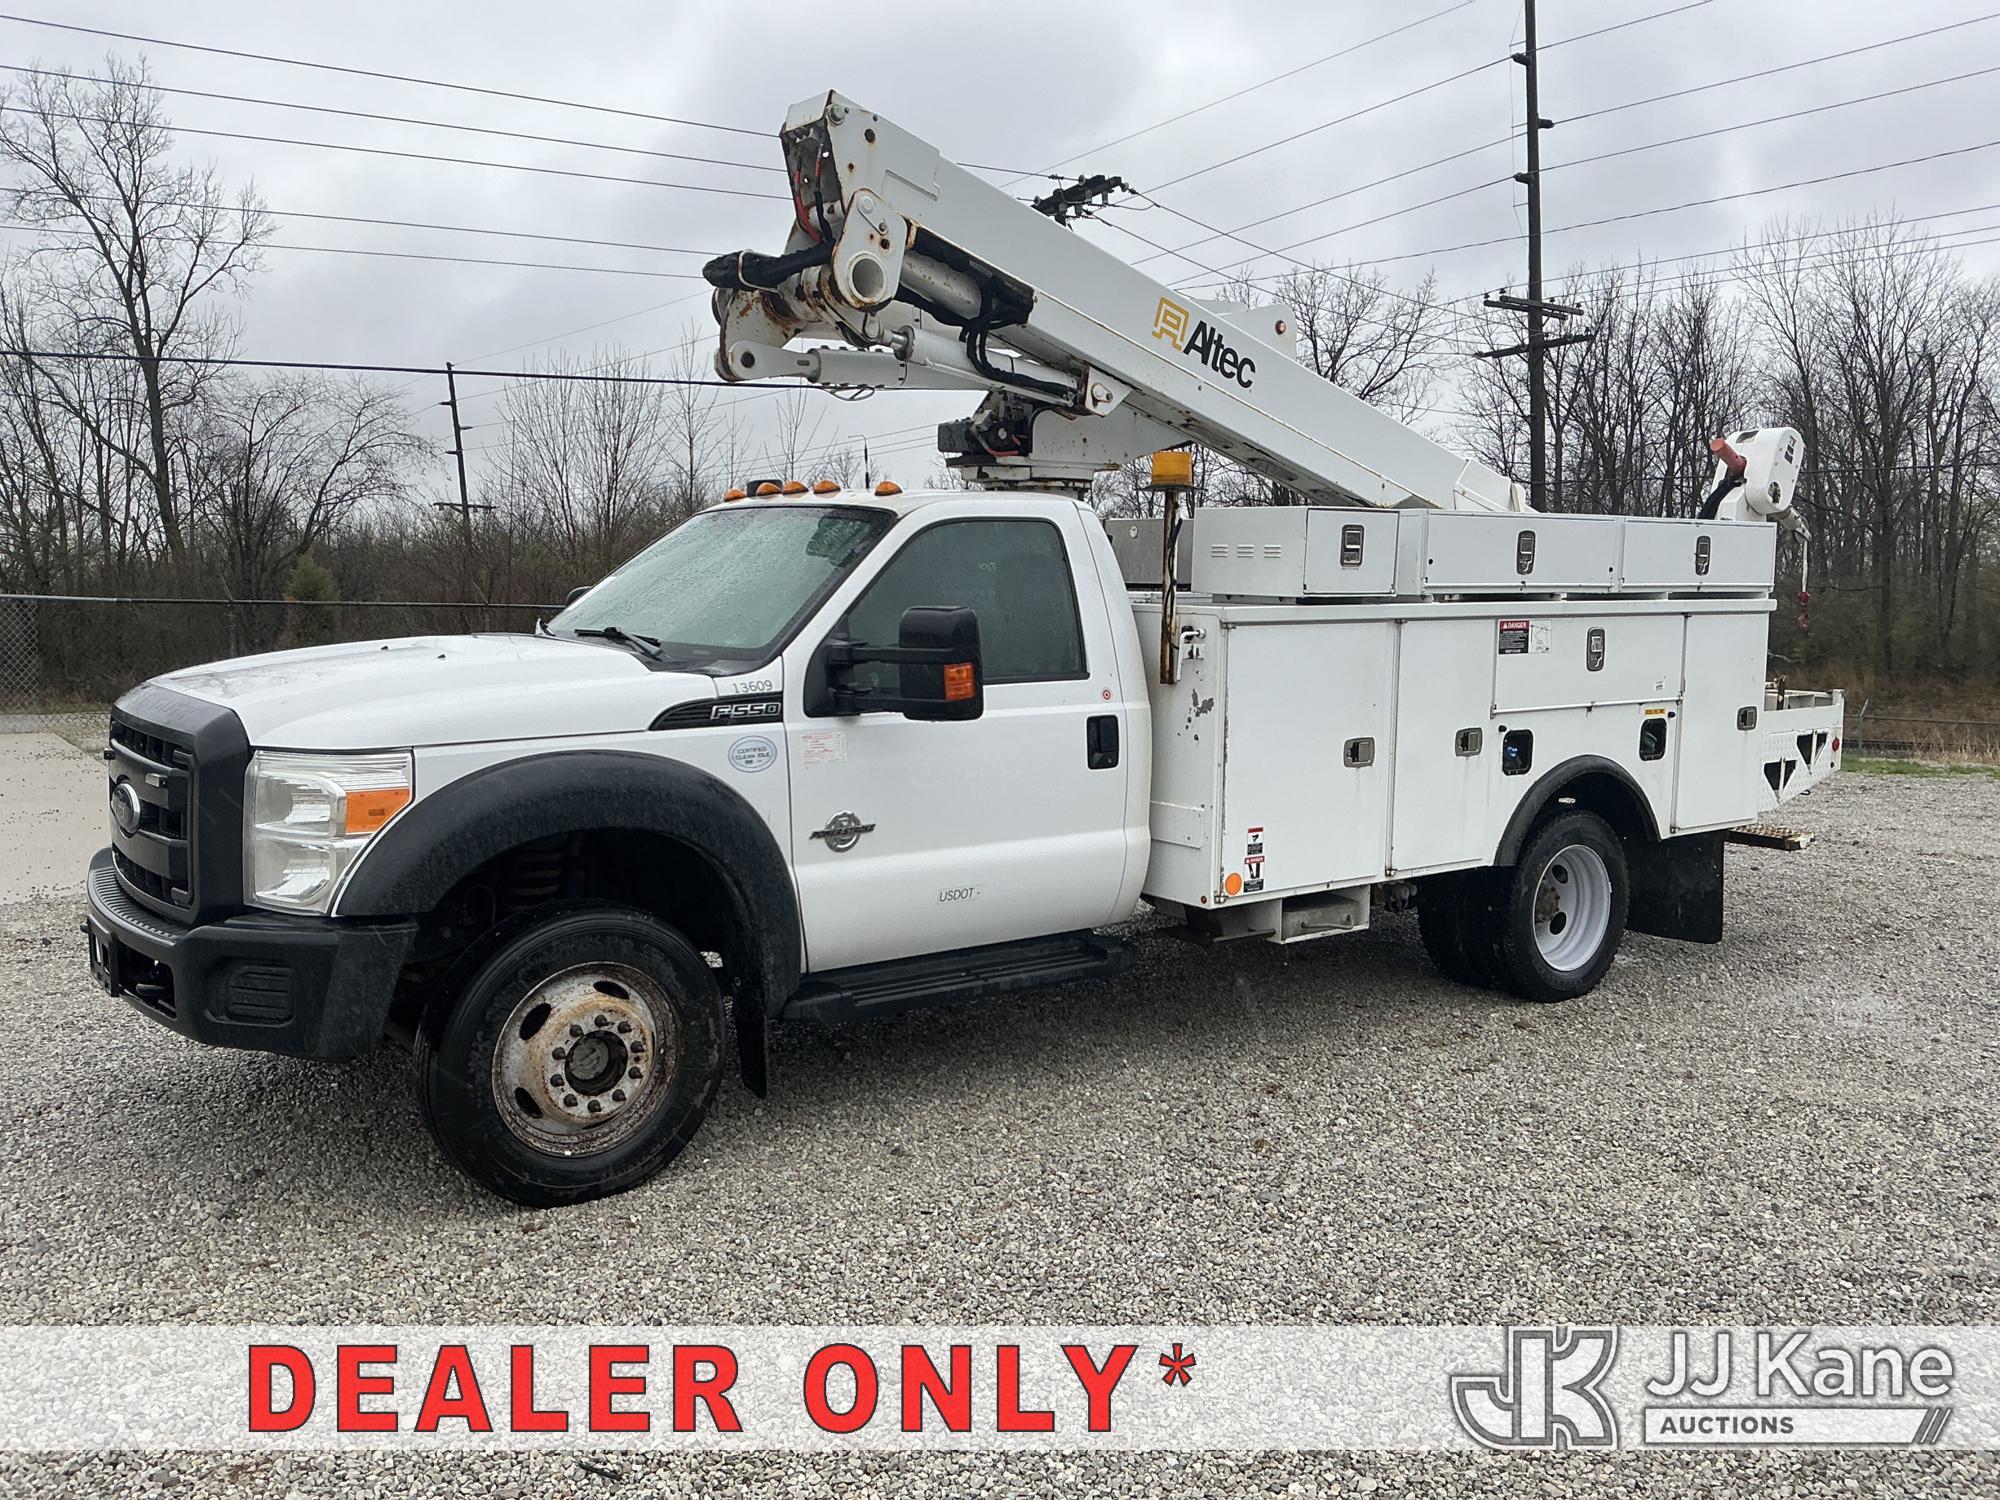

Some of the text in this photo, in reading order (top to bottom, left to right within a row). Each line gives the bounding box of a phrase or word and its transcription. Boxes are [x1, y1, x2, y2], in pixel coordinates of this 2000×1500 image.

[1182, 320, 1256, 389] Altec
[1507, 621, 1527, 630] DANGER
[732, 679, 773, 694] 13609
[939, 887, 975, 902] USDOT
